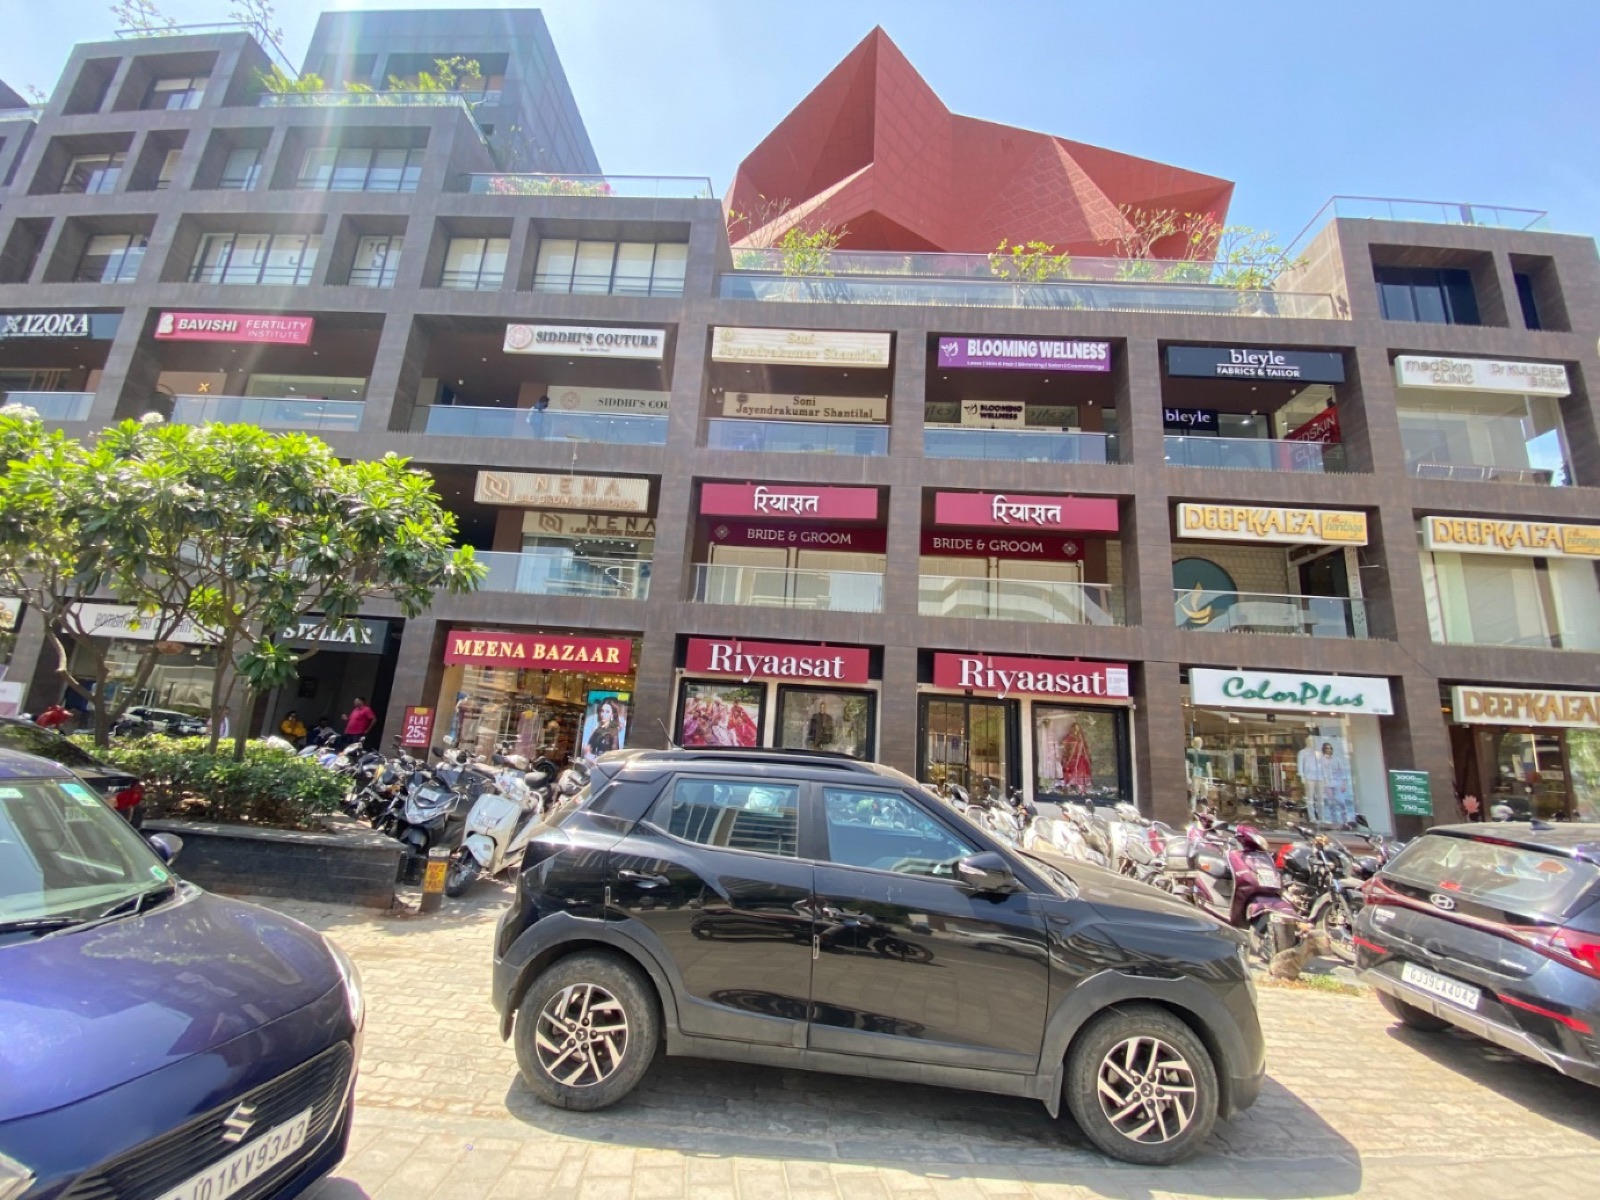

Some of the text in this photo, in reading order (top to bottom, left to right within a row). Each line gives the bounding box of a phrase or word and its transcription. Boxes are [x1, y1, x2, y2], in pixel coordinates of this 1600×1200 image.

[22, 313, 88, 333] IZORA
[178, 318, 239, 332] BAVISHI
[245, 319, 307, 330] FERTILITY
[248, 330, 300, 339] INSTITUTE
[536, 331, 658, 347] SIDDHI'S COUTURE
[967, 339, 1106, 360] BLOOMING WELLNESS
[1229, 349, 1286, 368] bleyle
[1216, 366, 1300, 378] FABRICS & TAILOR
[1432, 372, 1475, 385] CLINIC
[1506, 364, 1564, 378] KULDEEP
[598, 397, 646, 408] SIDDHI'S
[793, 396, 816, 407] Soni
[980, 404, 1023, 413] BLOOMING
[736, 403, 873, 419] Jayendrakumar Shantilal
[980, 412, 1018, 420] WELLNESS
[1165, 408, 1211, 425] bleyle
[535, 476, 620, 497] NENA
[754, 486, 820, 514] रियासत
[992, 495, 1062, 524] रियासत
[1184, 505, 1320, 536] DEEPKALA
[747, 529, 852, 545] BRIDE & GROOM
[1432, 518, 1563, 550] DEEPKALA
[932, 537, 1044, 553] BRIDE & GROOM
[453, 638, 621, 664] MEENA BAZAAR
[707, 641, 845, 683] Riyaasat
[958, 656, 1106, 699] Riyaasat
[1222, 676, 1365, 708] ColorPlus
[409, 716, 429, 725] FLAT
